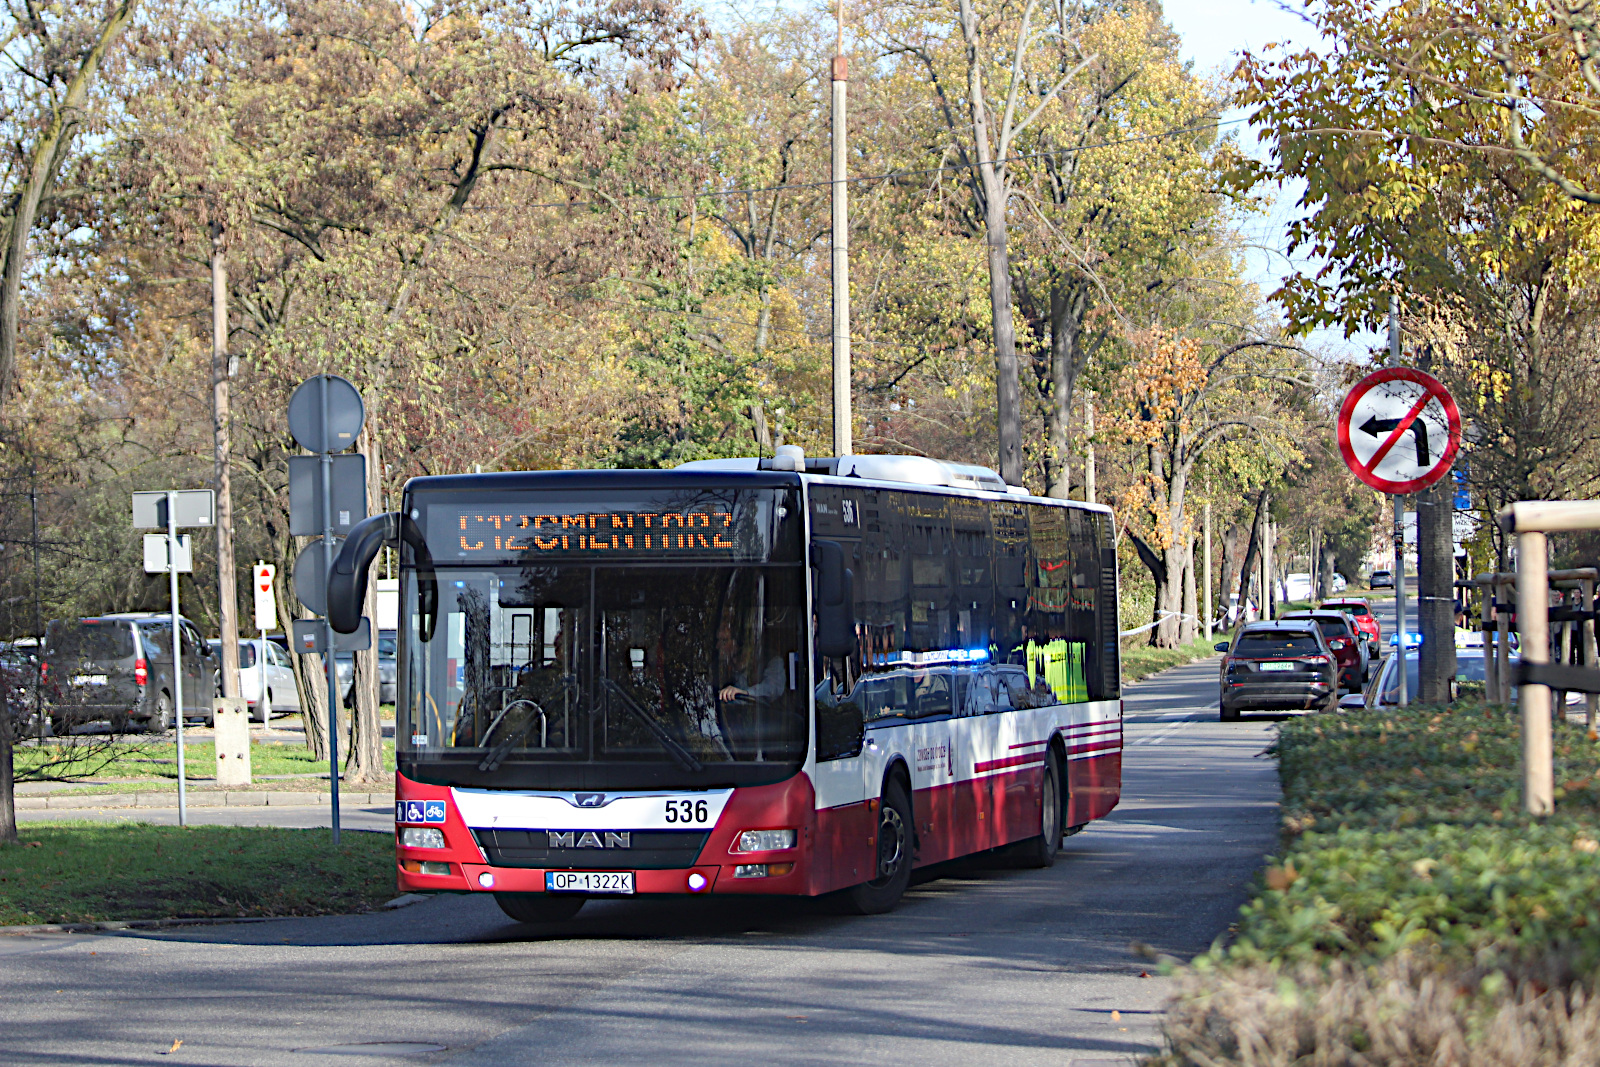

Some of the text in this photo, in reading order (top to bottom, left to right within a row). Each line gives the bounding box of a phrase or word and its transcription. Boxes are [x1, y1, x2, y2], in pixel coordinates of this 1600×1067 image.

[842, 500, 853, 523] 536
[665, 800, 708, 823] 536
[549, 831, 630, 848] MAN
[556, 874, 630, 889] OP 1322K
